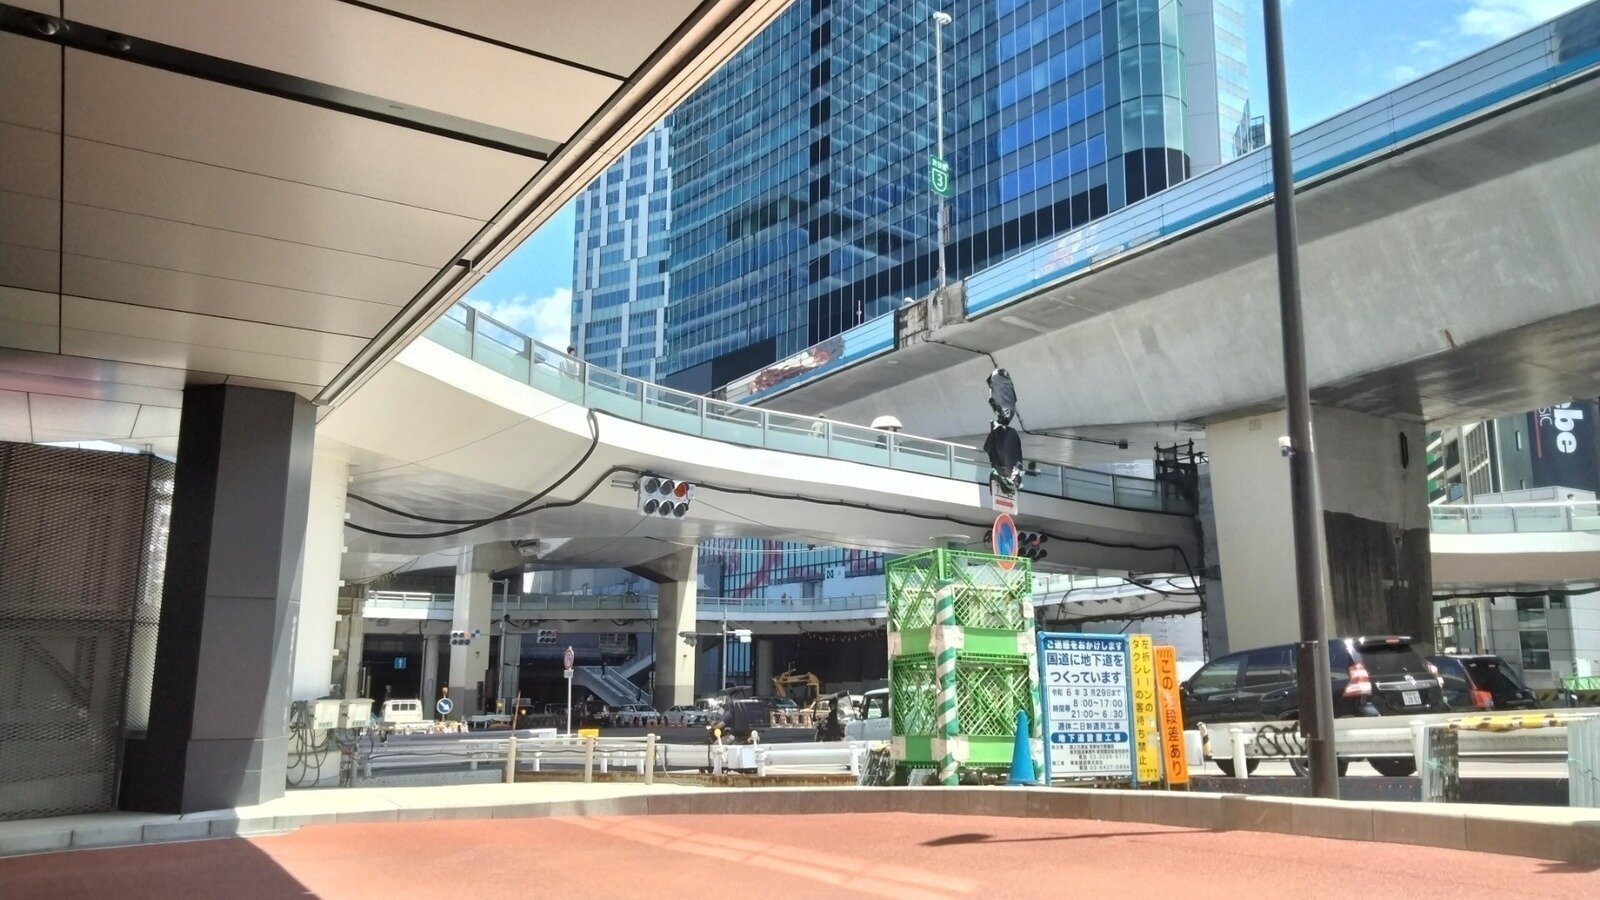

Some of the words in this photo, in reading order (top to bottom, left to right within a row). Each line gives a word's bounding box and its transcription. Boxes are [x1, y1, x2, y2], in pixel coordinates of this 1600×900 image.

[937, 173, 943, 187] 3
[1047, 640, 1122, 651] ご迷惑をおかけします
[1047, 652, 1123, 667] 国道に地下道を
[1050, 671, 1121, 684] つくっています
[1141, 640, 1153, 712] 左折レーンの
[1132, 640, 1147, 765] タクシーの客待ち禁止
[1161, 660, 1182, 776] この段差あり
